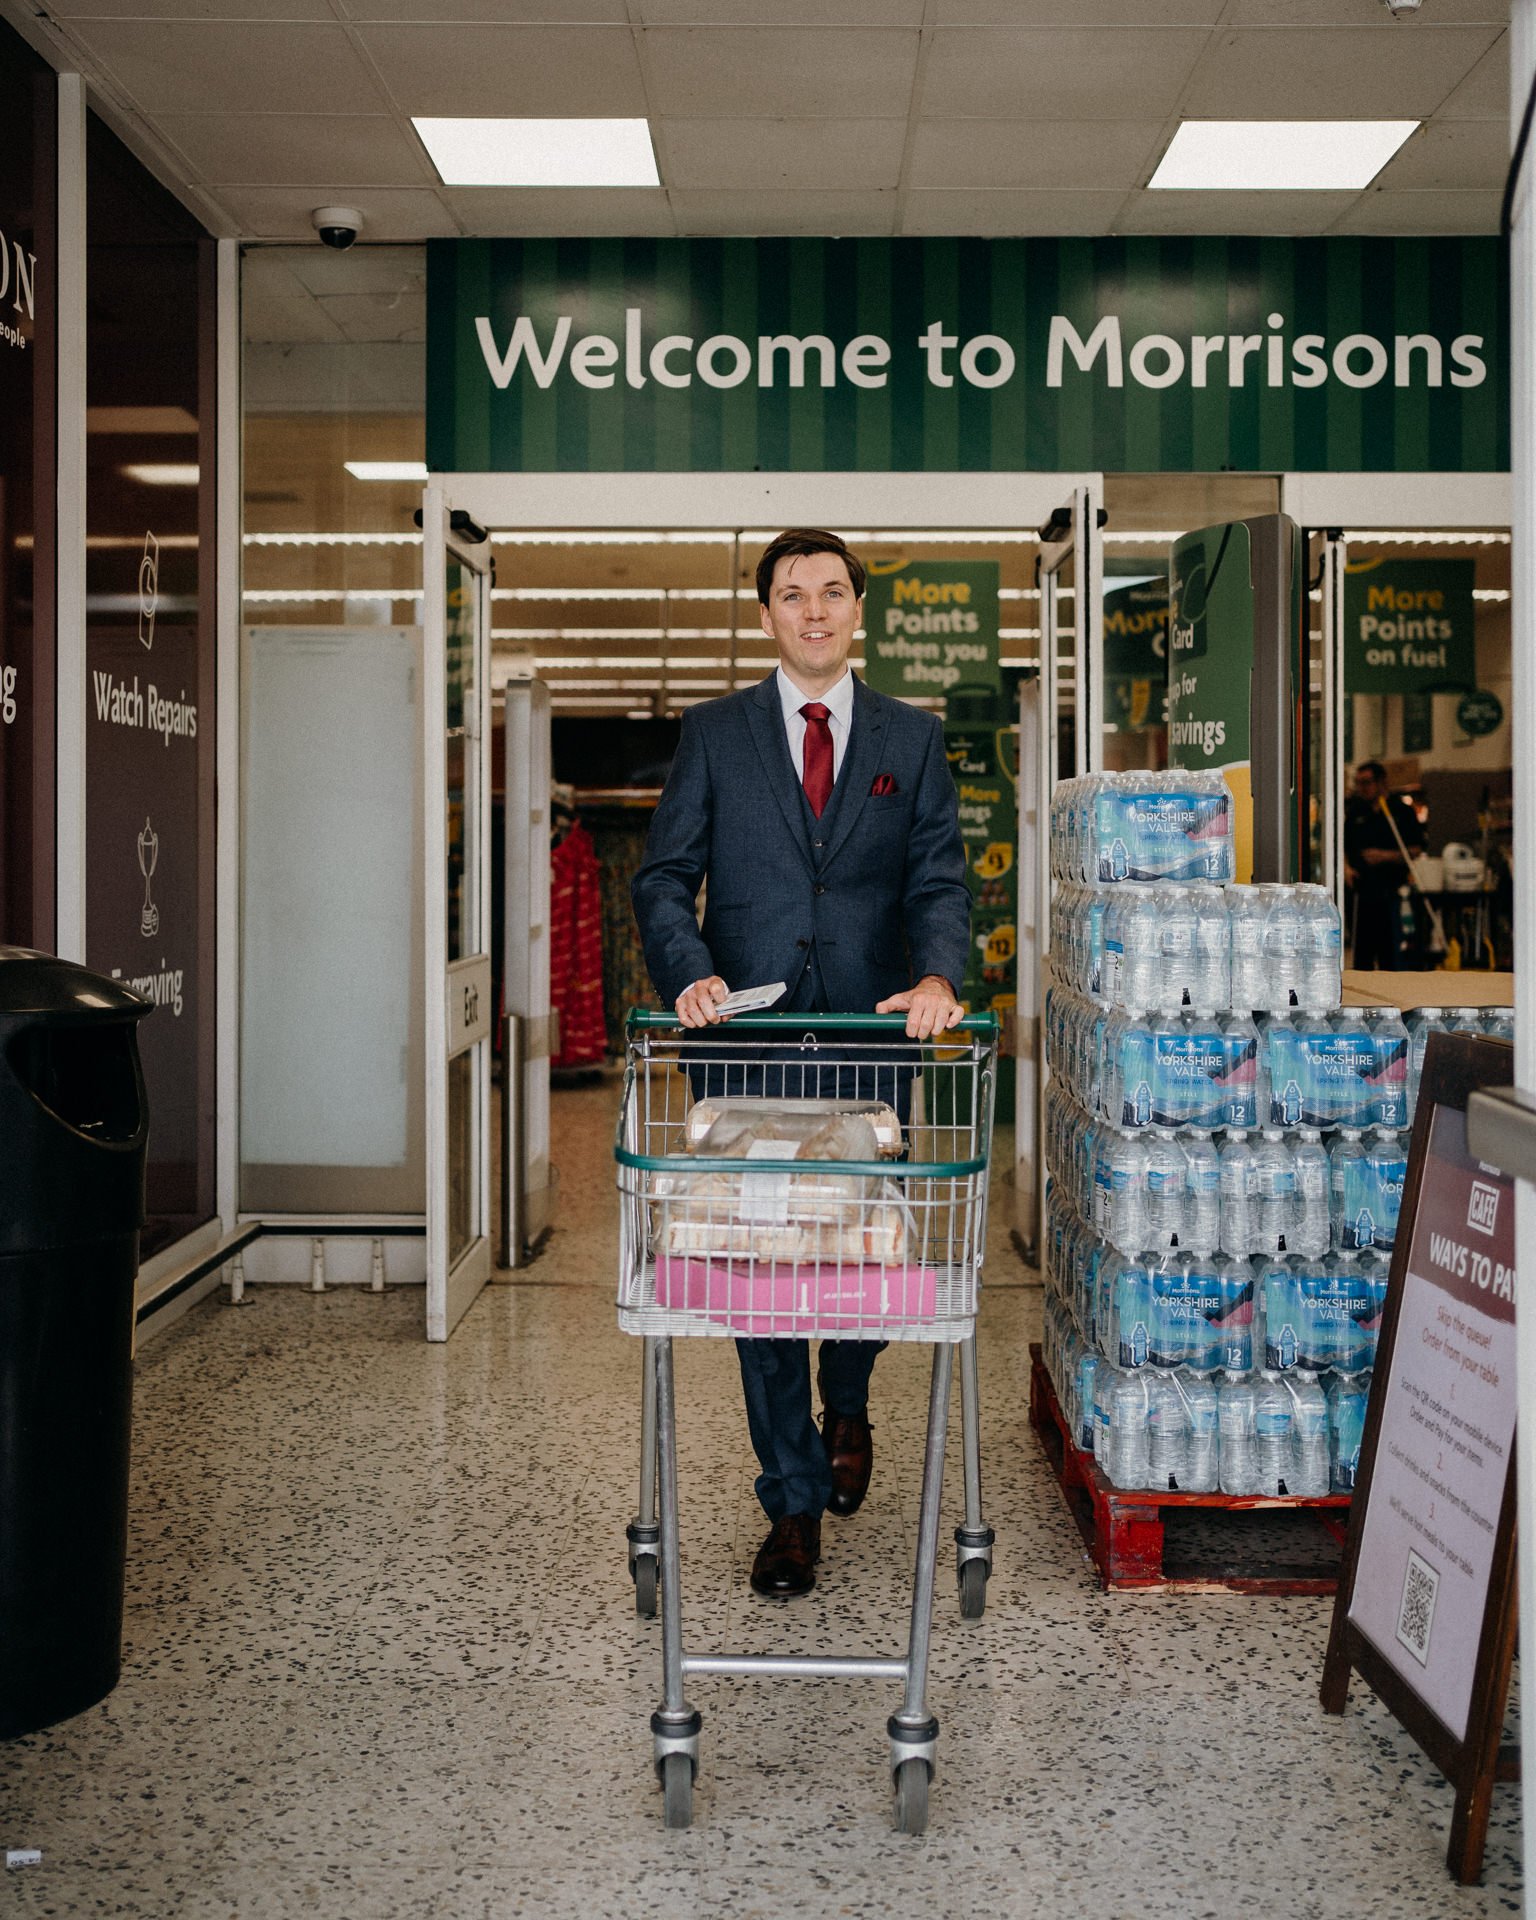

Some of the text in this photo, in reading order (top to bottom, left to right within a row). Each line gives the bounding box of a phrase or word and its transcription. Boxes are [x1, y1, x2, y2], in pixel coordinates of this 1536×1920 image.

[474, 307, 1486, 391] Welcome to Morrisons
[892, 578, 972, 606] More
[1367, 584, 1446, 612] More
[885, 607, 979, 635] Points
[1359, 614, 1453, 643] Points
[1172, 623, 1194, 651] Card
[876, 635, 989, 666] when you
[1365, 643, 1447, 668] on fuel
[902, 660, 961, 689] shop
[1181, 672, 1198, 694] for
[93, 669, 197, 747] Watch Repairs
[1170, 711, 1226, 756] savings
[959, 784, 1001, 802] More
[1130, 812, 1196, 823] YORKSHIRE
[1149, 823, 1177, 833] VALE
[1204, 859, 1219, 871] 12
[1155, 1056, 1223, 1066] YORKSHIRE
[1305, 1054, 1373, 1065] YORKSHIRE
[1174, 1066, 1204, 1077] VALE
[1324, 1065, 1355, 1076] VALE
[1230, 1105, 1245, 1118] 12
[1381, 1104, 1396, 1117] 12
[1429, 1232, 1467, 1280] WAYS
[1470, 1253, 1492, 1290] TO
[1152, 1297, 1220, 1308] YORKSHIRE
[1300, 1298, 1367, 1310] YORKSHIRE
[1171, 1308, 1201, 1319] VALE
[1319, 1310, 1350, 1320] VALE
[1453, 1317, 1466, 1334] the
[1227, 1347, 1242, 1362] 12
[1422, 1327, 1443, 1351] Order
[1443, 1338, 1461, 1364] from
[1461, 1353, 1480, 1374] your
[1411, 1383, 1421, 1400] the
[1420, 1391, 1429, 1406] QR
[1429, 1398, 1442, 1416] code
[1442, 1408, 1451, 1420] on
[1450, 1415, 1464, 1430] your
[1409, 1405, 1425, 1424] Order
[1425, 1416, 1436, 1434] and
[1444, 1430, 1454, 1445] for
[1452, 1440, 1467, 1455] your
